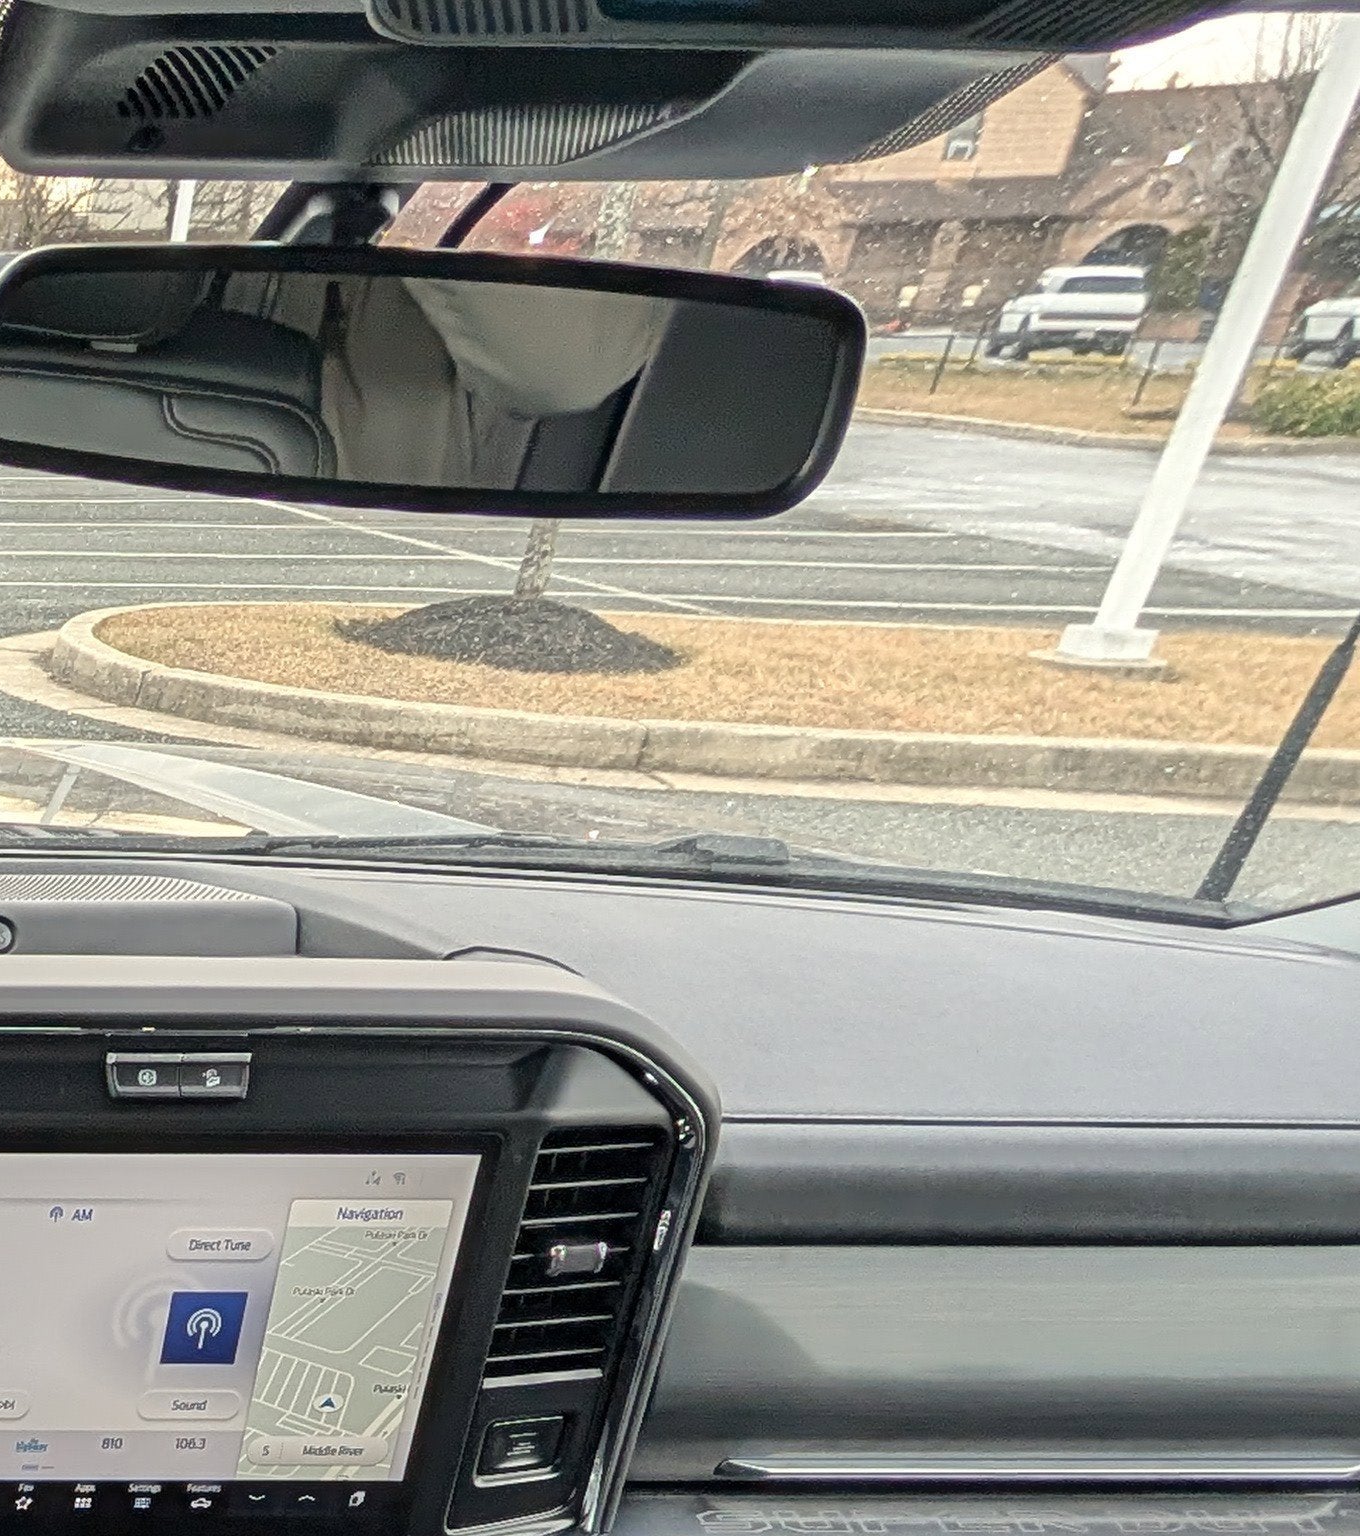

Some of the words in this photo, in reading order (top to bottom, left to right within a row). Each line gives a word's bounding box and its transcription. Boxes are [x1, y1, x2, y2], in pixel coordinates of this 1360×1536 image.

[71, 1208, 94, 1222] AM
[336, 1207, 404, 1222] Navigation
[188, 1238, 221, 1251] Direct
[223, 1238, 252, 1252] Tune
[171, 1398, 208, 1411] Sound
[100, 1437, 124, 1450] 810
[175, 1437, 207, 1451] 106.3
[301, 1445, 337, 1457] Middle
[337, 1445, 365, 1458] River
[73, 1483, 97, 1494] Apps
[127, 1483, 162, 1495] Settings
[186, 1483, 223, 1494] Features
